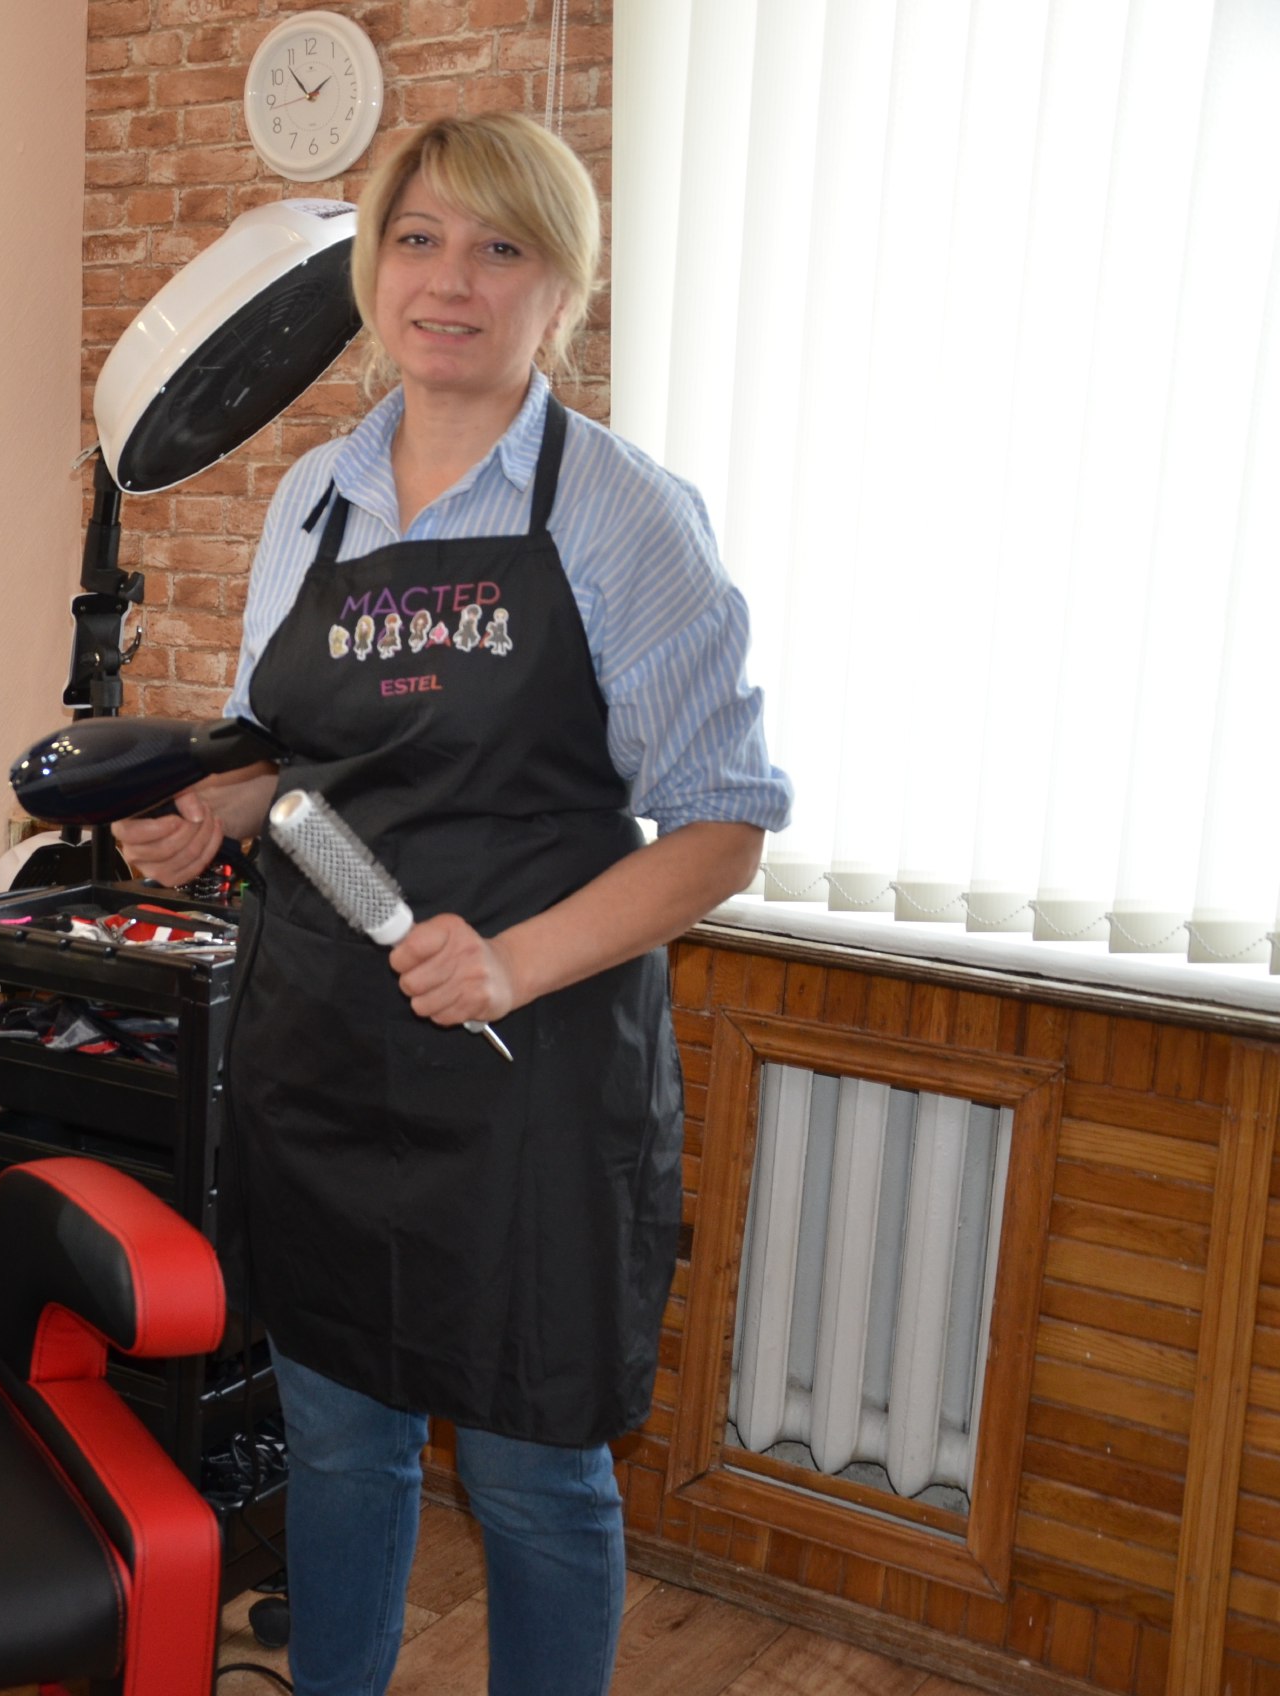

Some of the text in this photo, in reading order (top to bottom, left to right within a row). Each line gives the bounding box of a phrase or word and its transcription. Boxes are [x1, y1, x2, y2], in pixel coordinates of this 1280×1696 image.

[304, 37, 318, 56] 12
[287, 48, 295, 65] 11
[344, 58, 354, 76] 2
[271, 68, 284, 86] 10
[266, 94, 277, 111] 9
[272, 116, 282, 134] 8
[289, 132, 298, 150] 7
[329, 127, 340, 145] 5
[308, 138, 319, 156] 6
[339, 581, 501, 620] МАСТЕР
[380, 674, 443, 697] ESTEL
